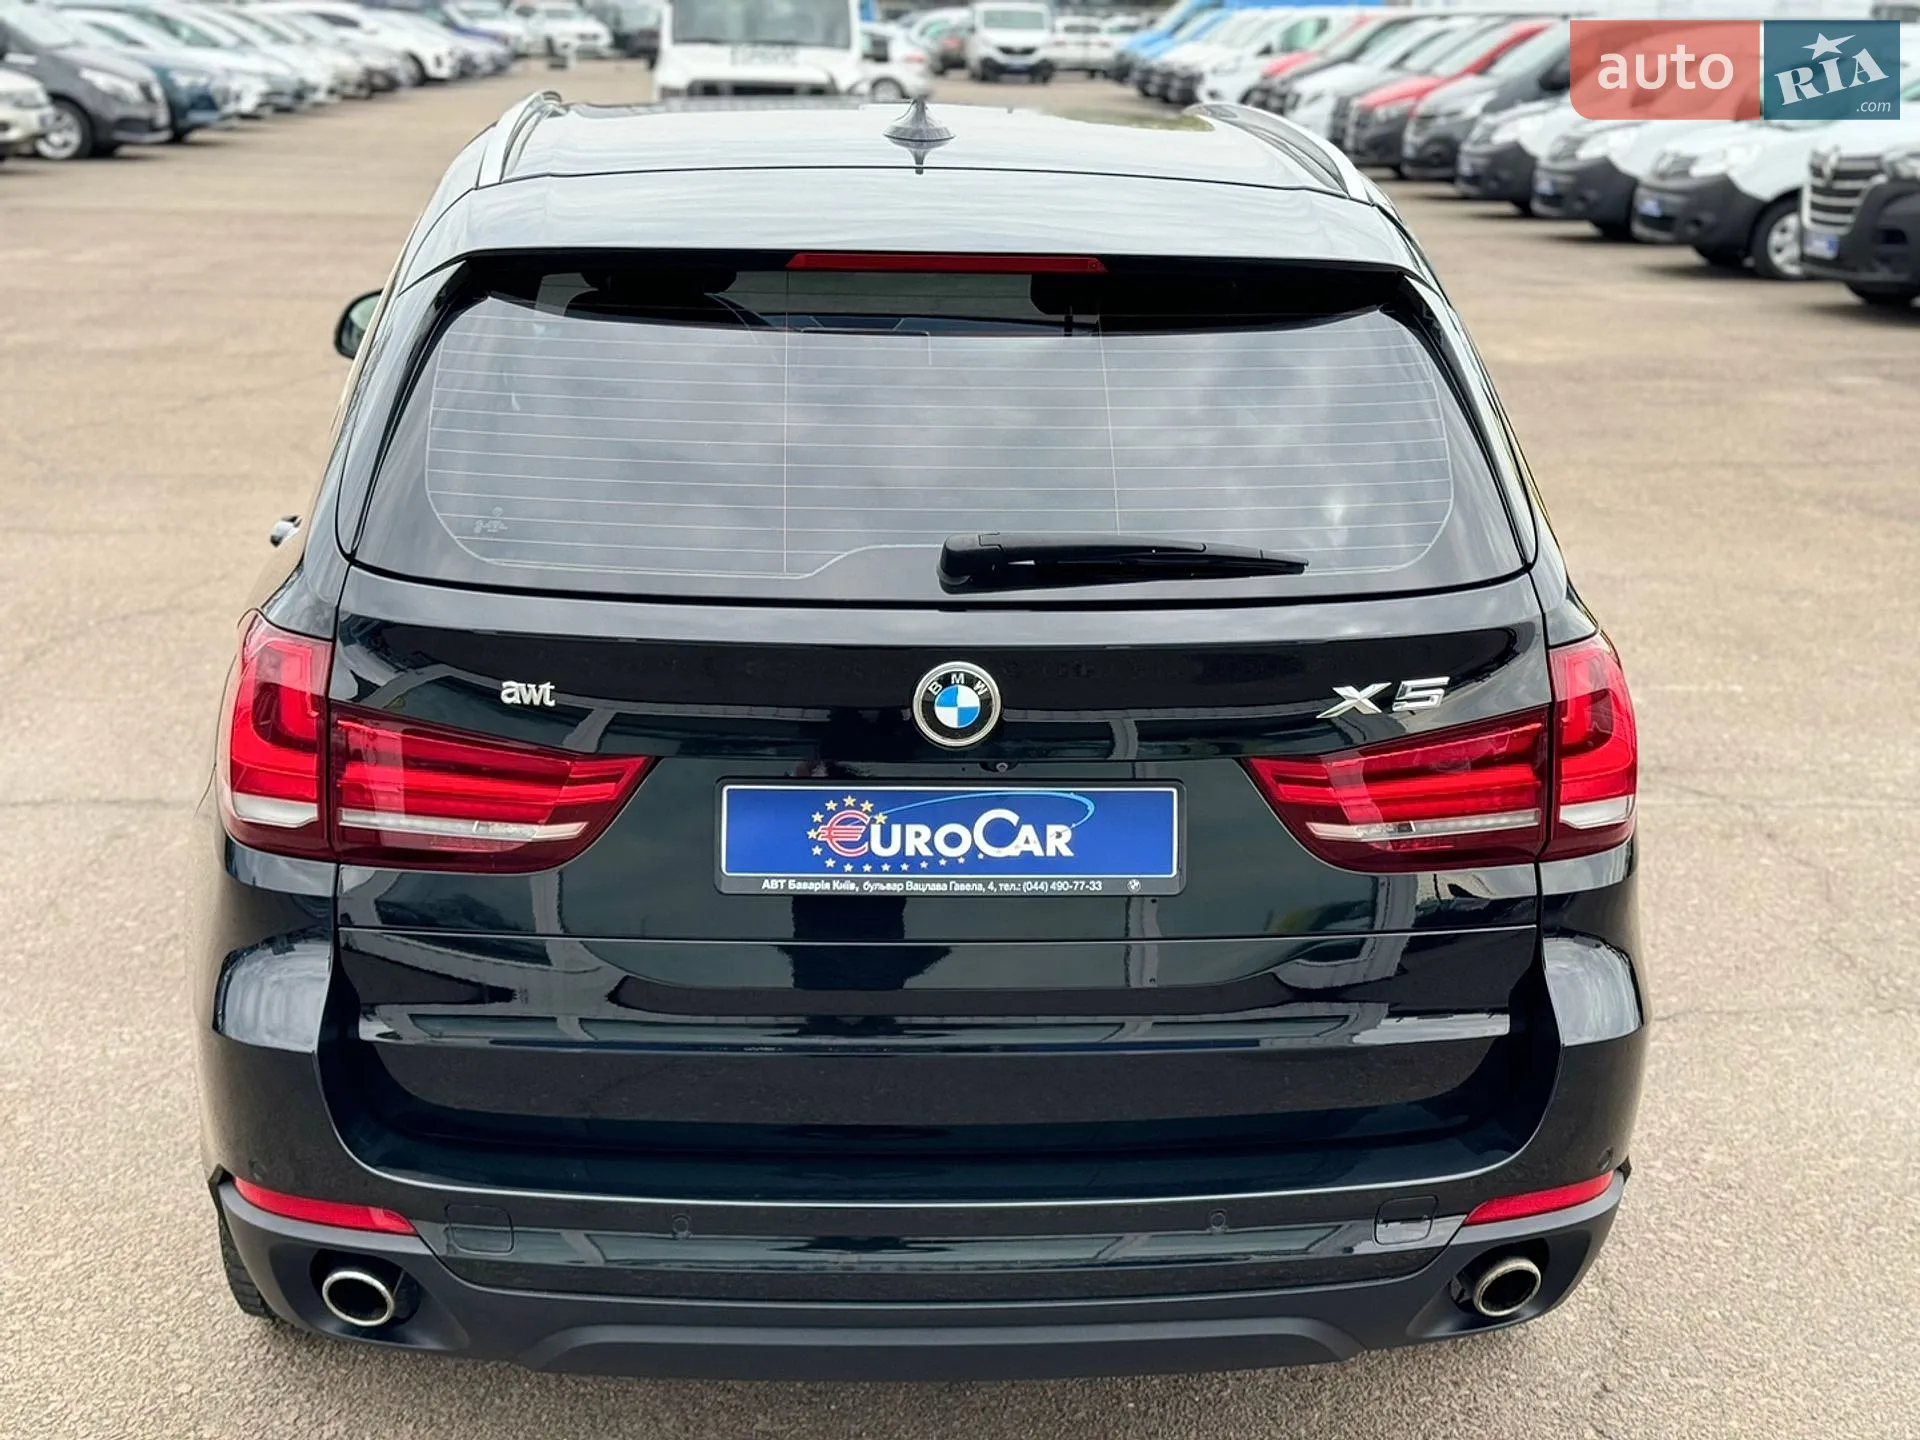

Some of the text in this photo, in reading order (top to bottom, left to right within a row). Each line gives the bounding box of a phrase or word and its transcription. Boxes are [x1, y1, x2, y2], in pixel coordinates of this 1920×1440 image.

[501, 680, 556, 707] awt
[927, 672, 988, 696] BMW
[1316, 676, 1450, 718] X5
[1022, 880, 1049, 893] (044)
[1050, 880, 1103, 892] 490-77-33
